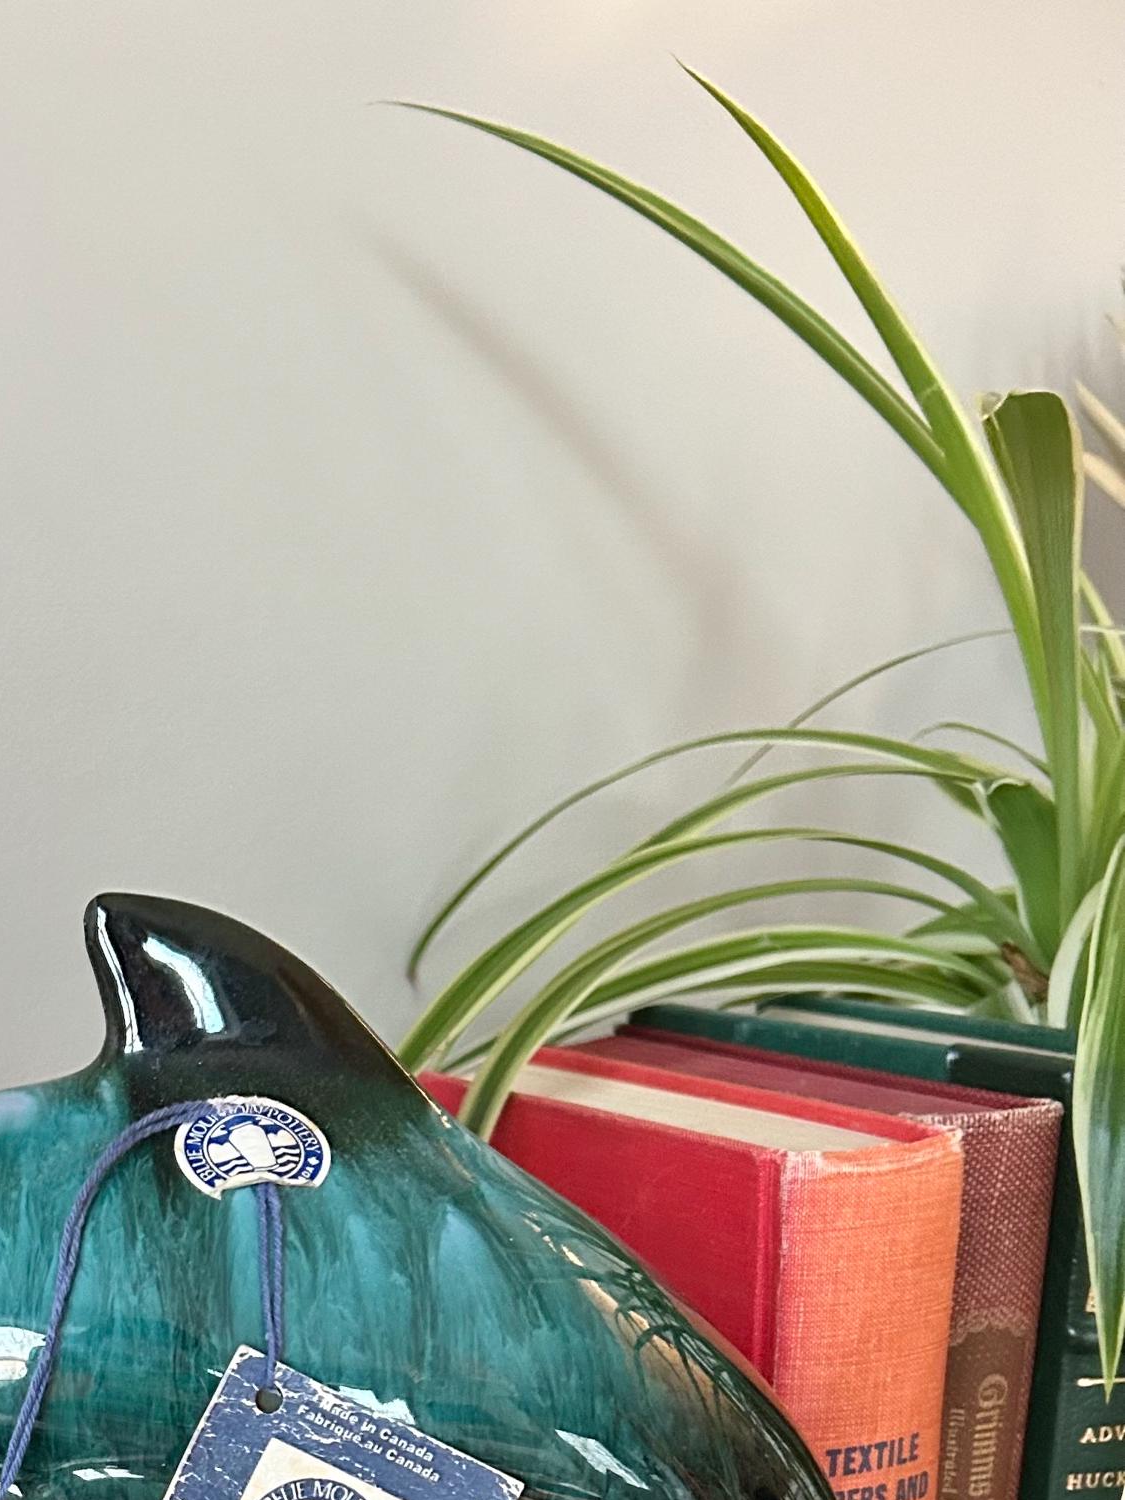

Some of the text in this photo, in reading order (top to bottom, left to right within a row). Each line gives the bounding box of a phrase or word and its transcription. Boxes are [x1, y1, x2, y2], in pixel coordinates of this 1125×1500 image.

[186, 1149, 217, 1183] BLUE
[267, 1106, 322, 1154] POTTERY
[297, 1404, 441, 1483] Fabriqué au Canada
[319, 1398, 435, 1463] Made in Canada
[825, 1432, 920, 1478] TEXTILE
